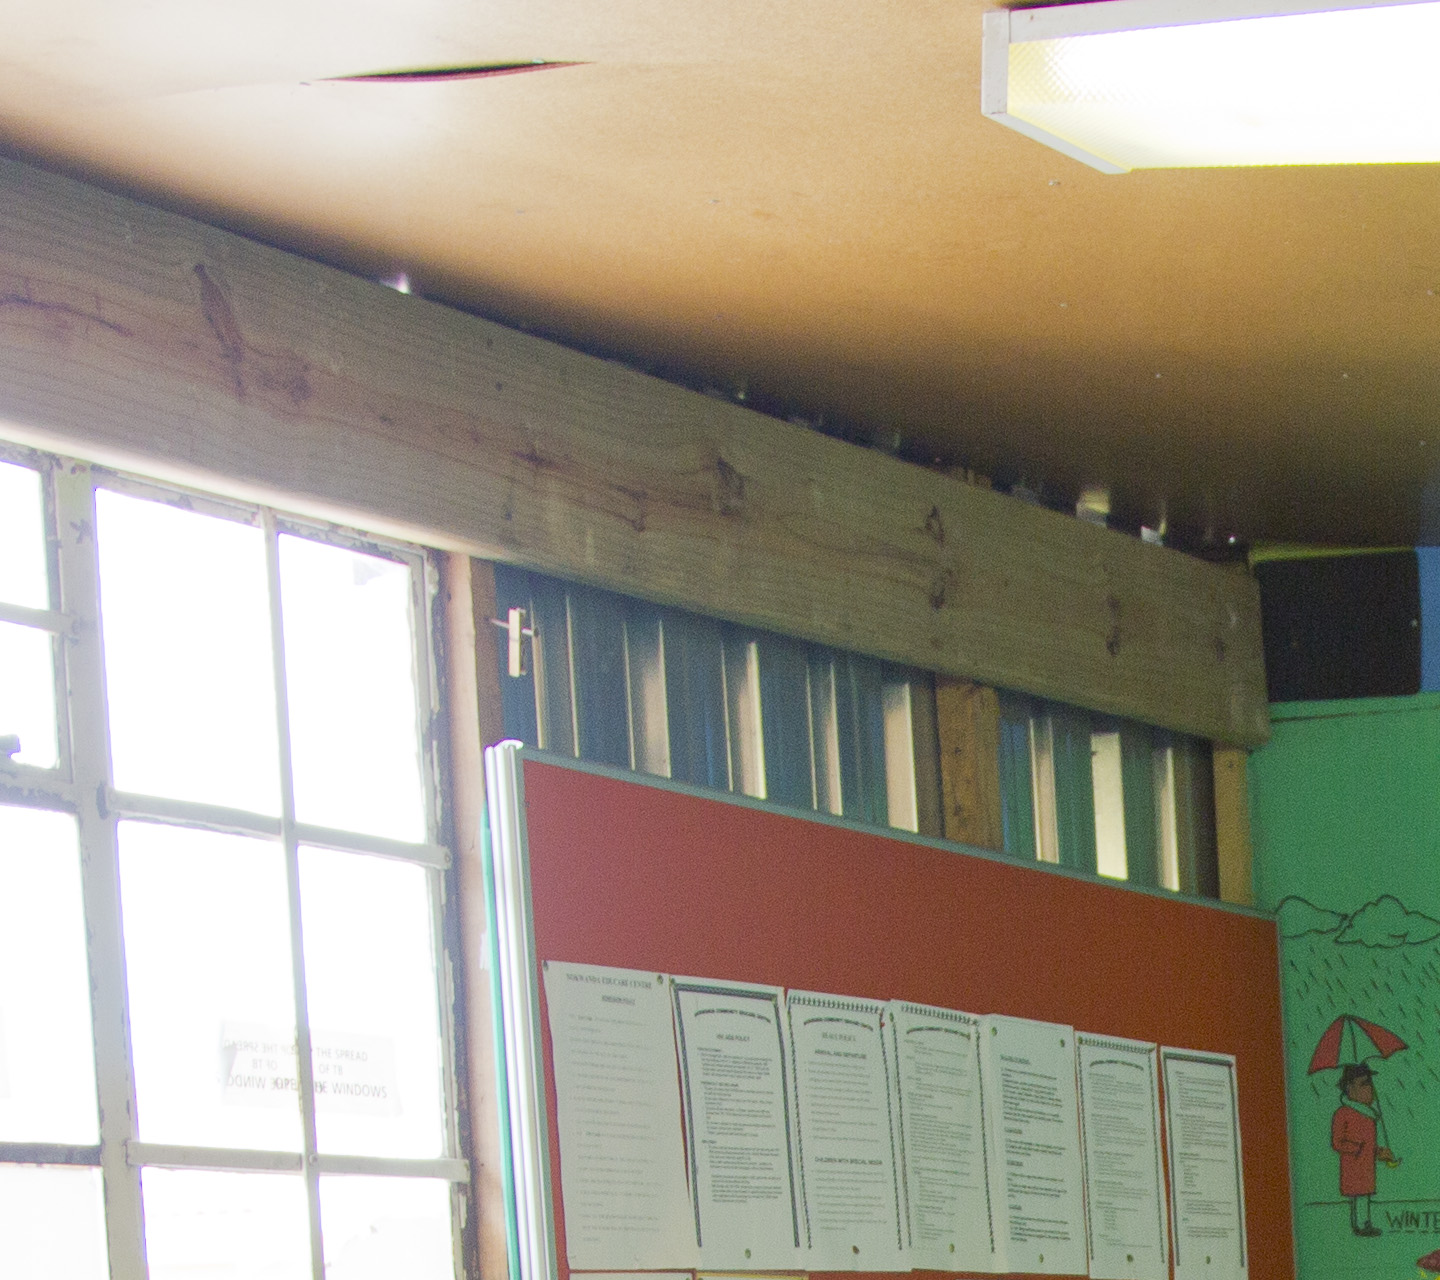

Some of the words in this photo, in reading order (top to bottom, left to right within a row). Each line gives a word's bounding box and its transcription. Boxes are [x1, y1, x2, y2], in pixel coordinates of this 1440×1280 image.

[316, 1046, 332, 1060] THE
[335, 1048, 368, 1063] SPREAD
[318, 1063, 330, 1075] OF
[333, 1064, 344, 1077] TB
[331, 1081, 388, 1100] WINDOWS
